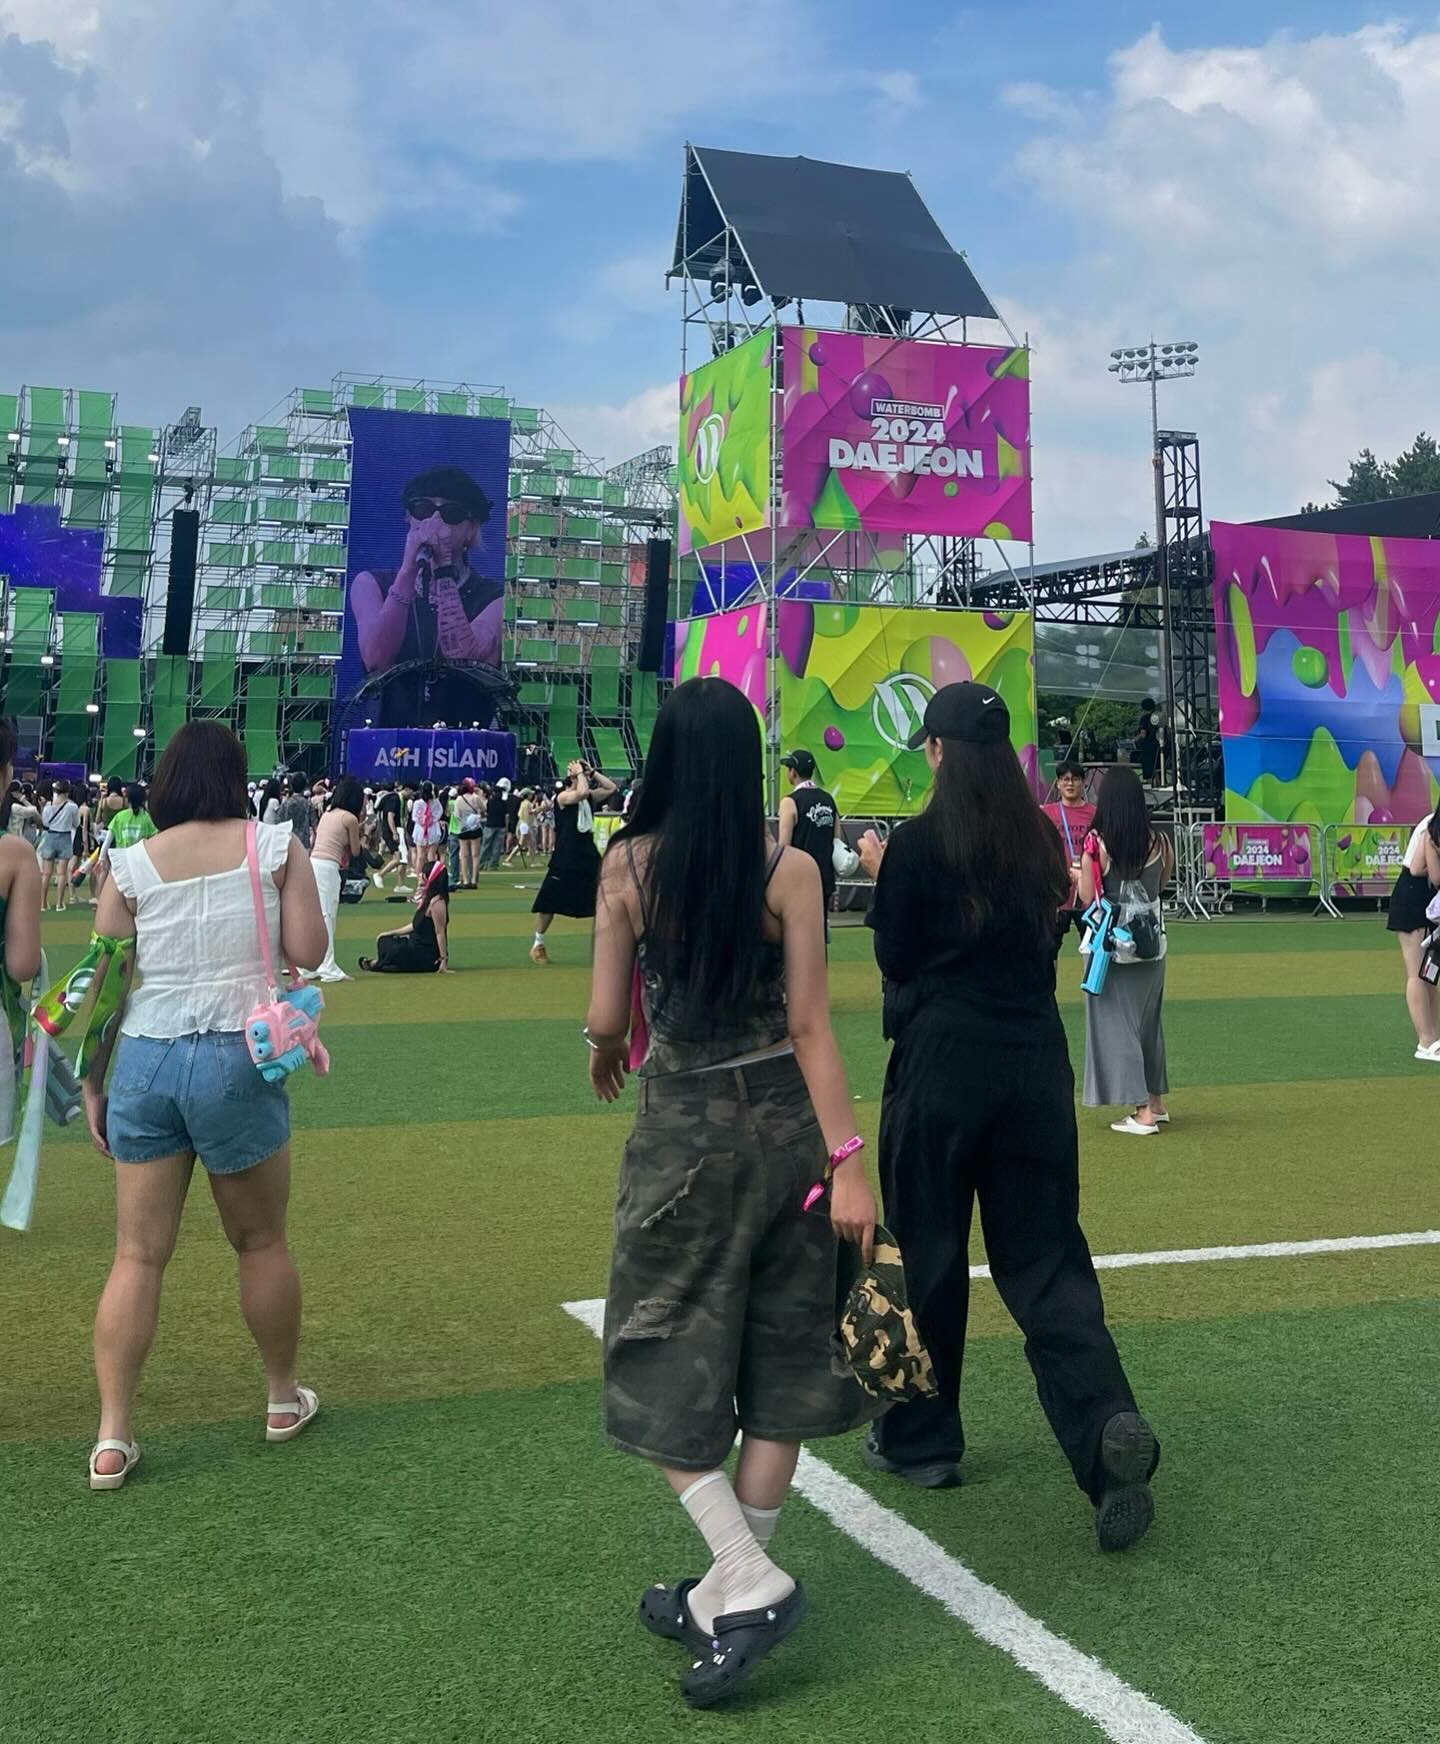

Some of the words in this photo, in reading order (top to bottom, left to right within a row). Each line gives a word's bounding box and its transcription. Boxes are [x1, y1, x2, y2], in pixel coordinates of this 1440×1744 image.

[874, 402, 941, 418] WATERBOMB
[871, 418, 945, 443] 2024
[828, 438, 984, 478] DAEJEON
[374, 747, 420, 767] ASH
[427, 747, 499, 769] ISLAND
[1246, 845, 1269, 854] 2024
[1377, 846, 1400, 855] 2024
[1232, 854, 1283, 866] DAEJEON
[1365, 855, 1405, 865] DAEJEO
